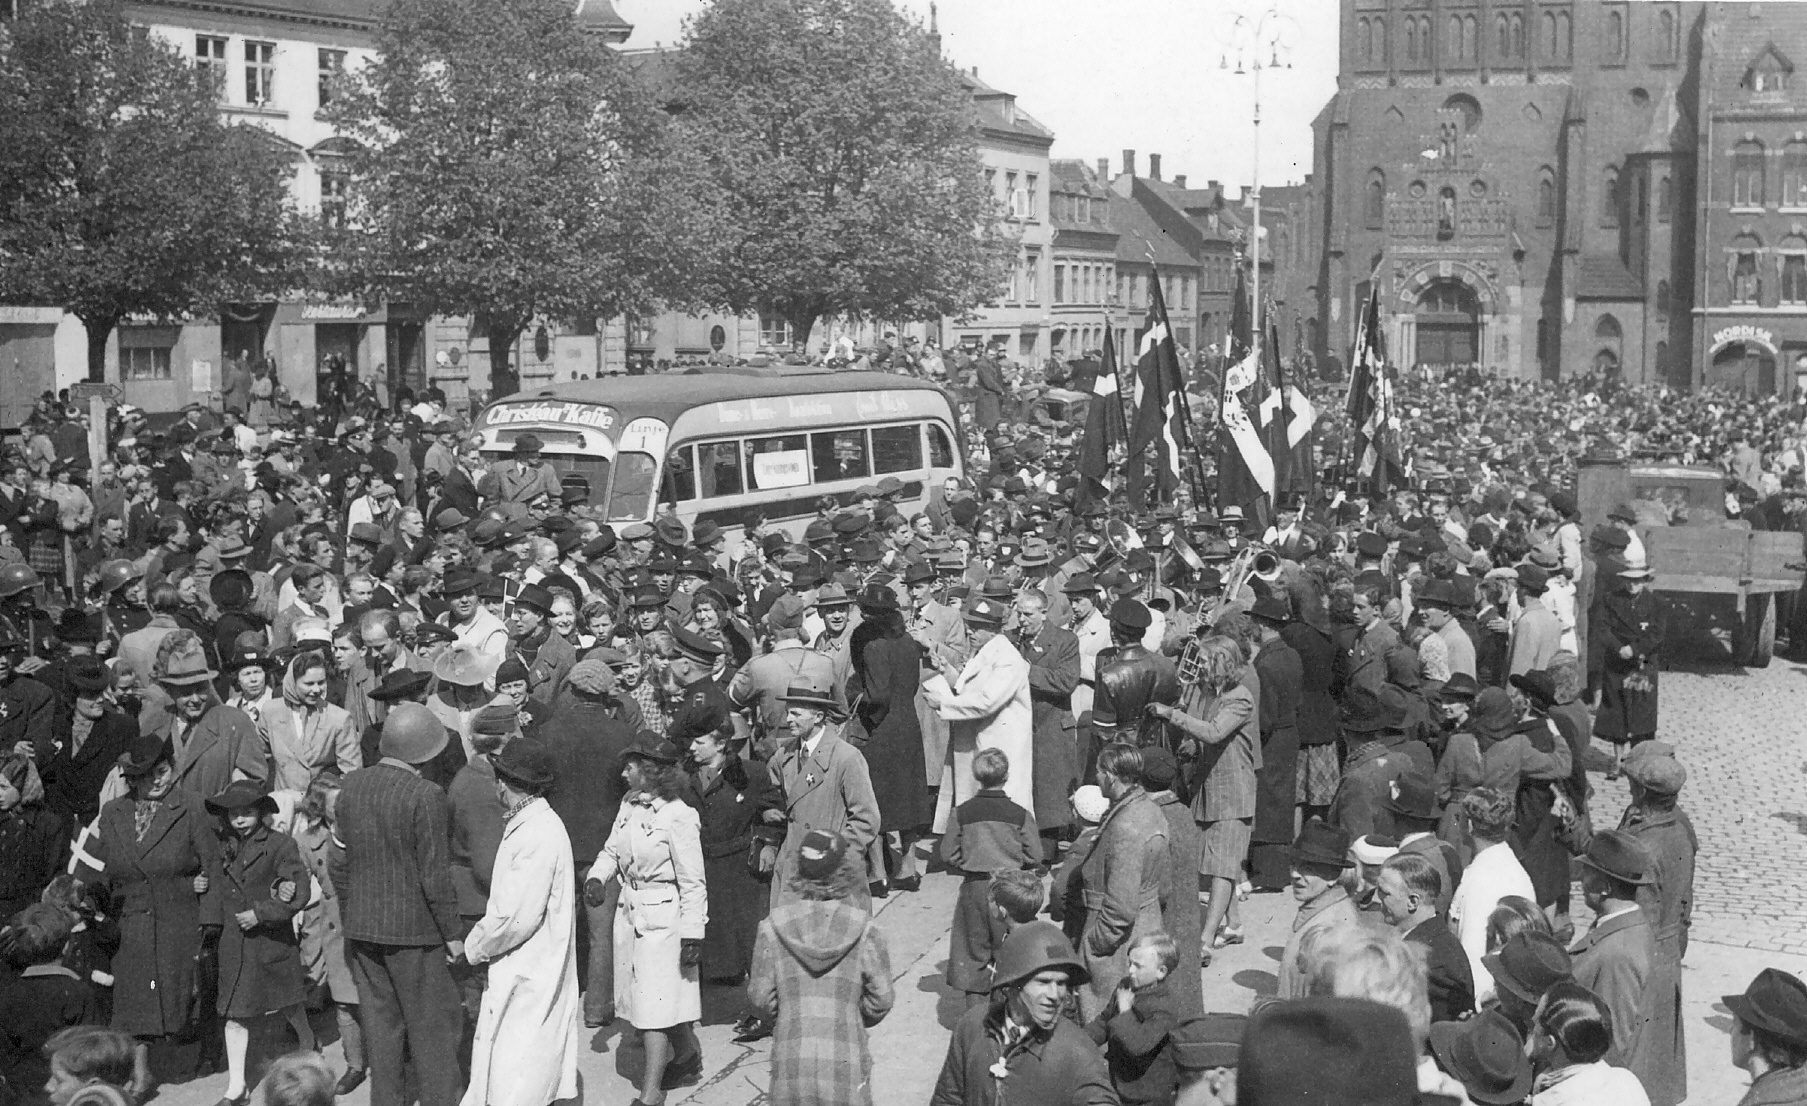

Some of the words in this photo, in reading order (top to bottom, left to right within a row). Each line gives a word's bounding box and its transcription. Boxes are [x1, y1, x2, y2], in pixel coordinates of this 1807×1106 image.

[563, 403, 614, 429] Kaffe
[631, 423, 666, 436] Linje
[641, 436, 646, 448] 1
